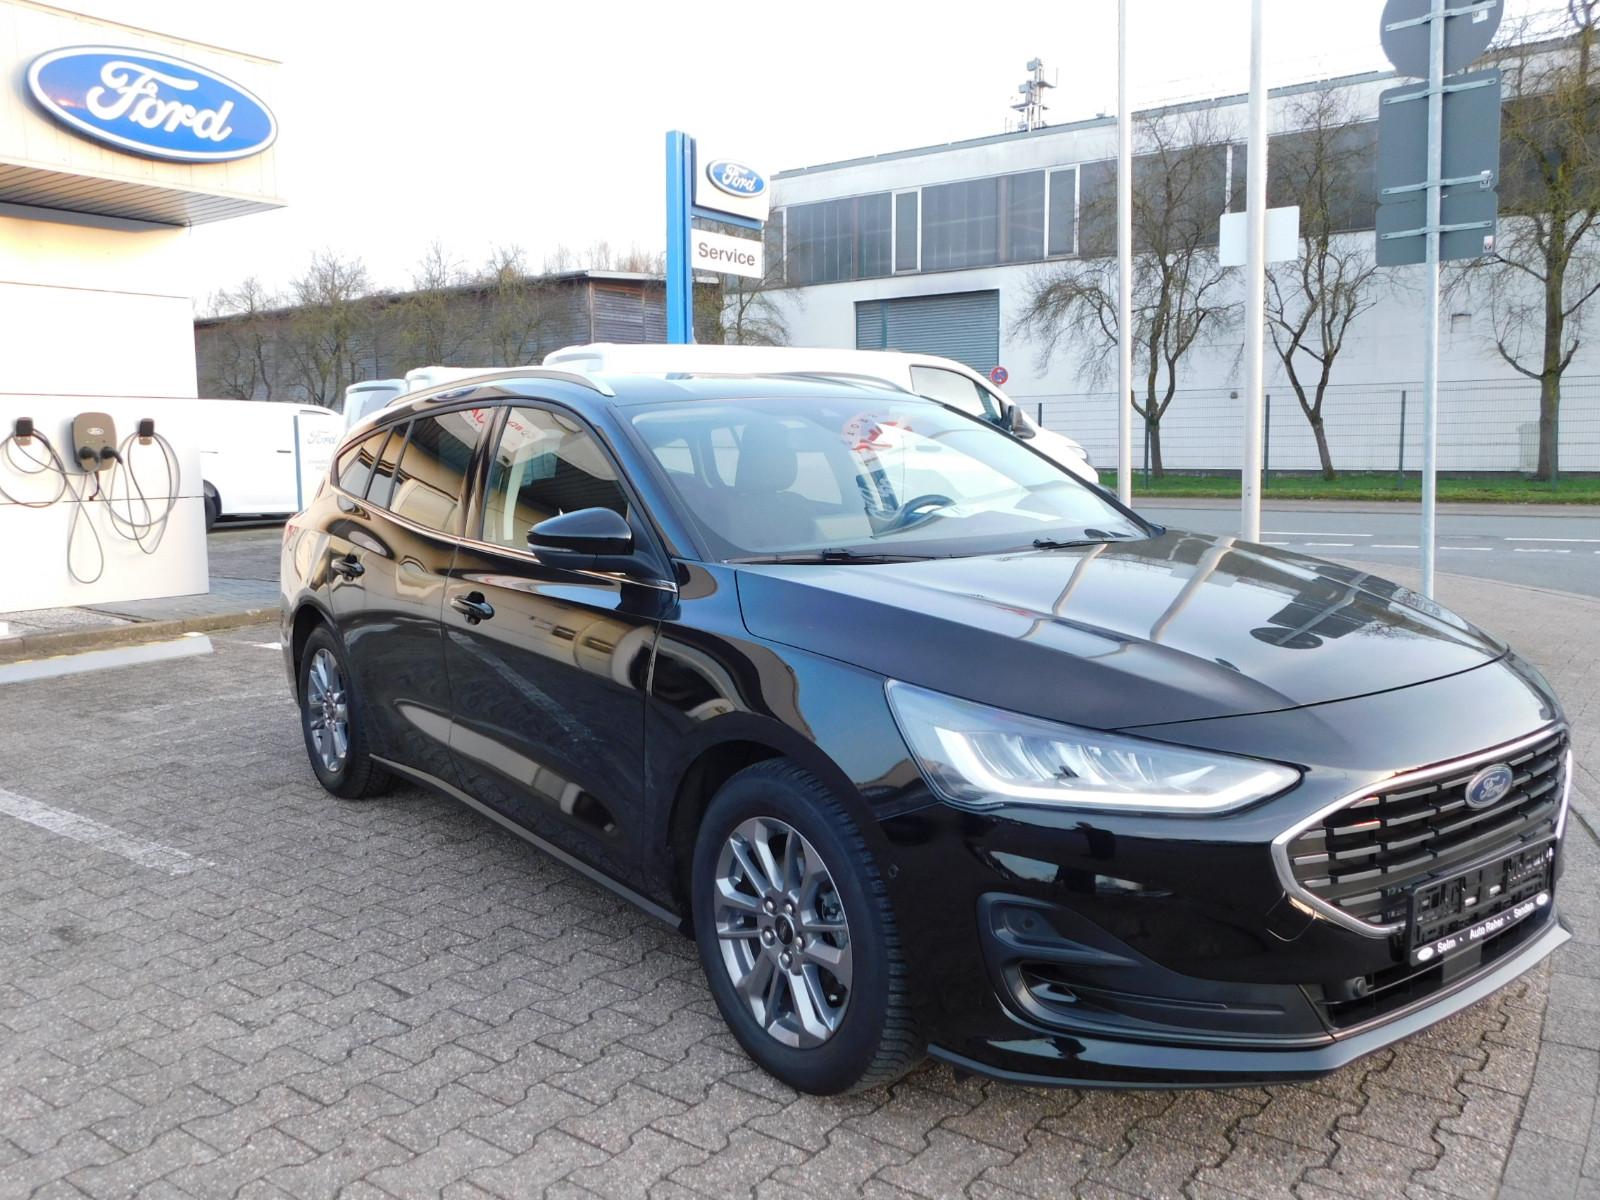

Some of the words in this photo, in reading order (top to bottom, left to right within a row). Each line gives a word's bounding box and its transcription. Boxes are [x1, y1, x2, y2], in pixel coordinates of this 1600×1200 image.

[86, 61, 234, 142] Ford
[722, 164, 756, 192] Ford
[698, 241, 756, 267] Service
[1480, 776, 1506, 800] Ford
[1470, 926, 1486, 940] Auto
